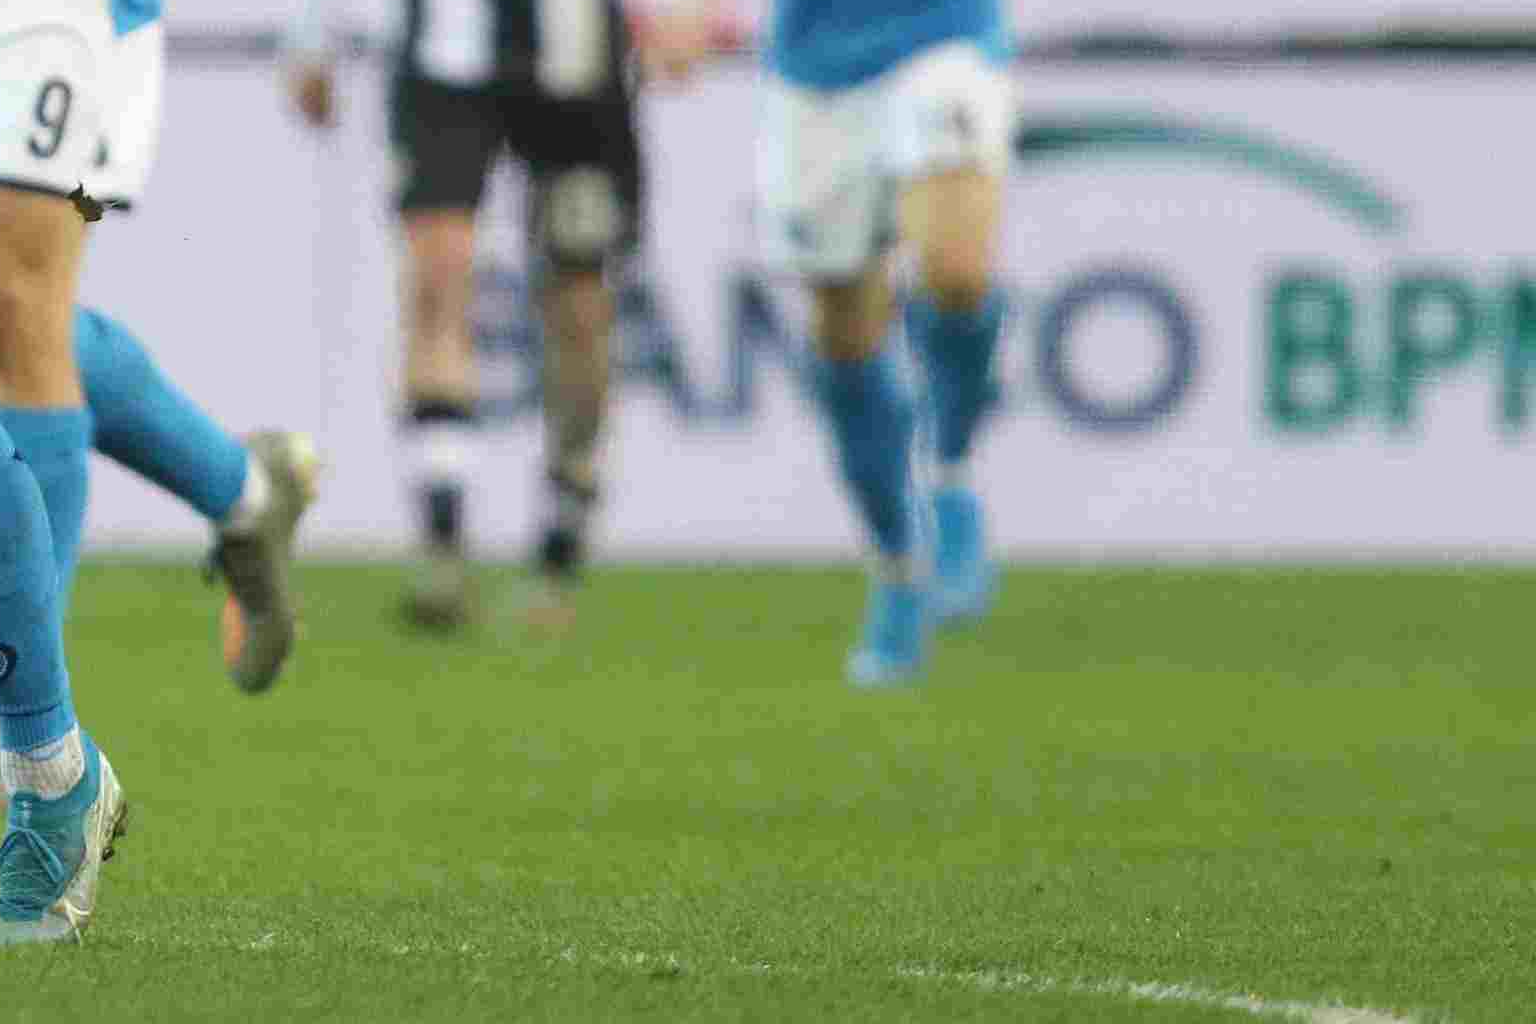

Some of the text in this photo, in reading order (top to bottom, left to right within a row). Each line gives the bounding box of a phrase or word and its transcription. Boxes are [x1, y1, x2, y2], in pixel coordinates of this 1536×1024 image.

[28, 79, 72, 159] 9
[469, 268, 1536, 432] BANO BP
